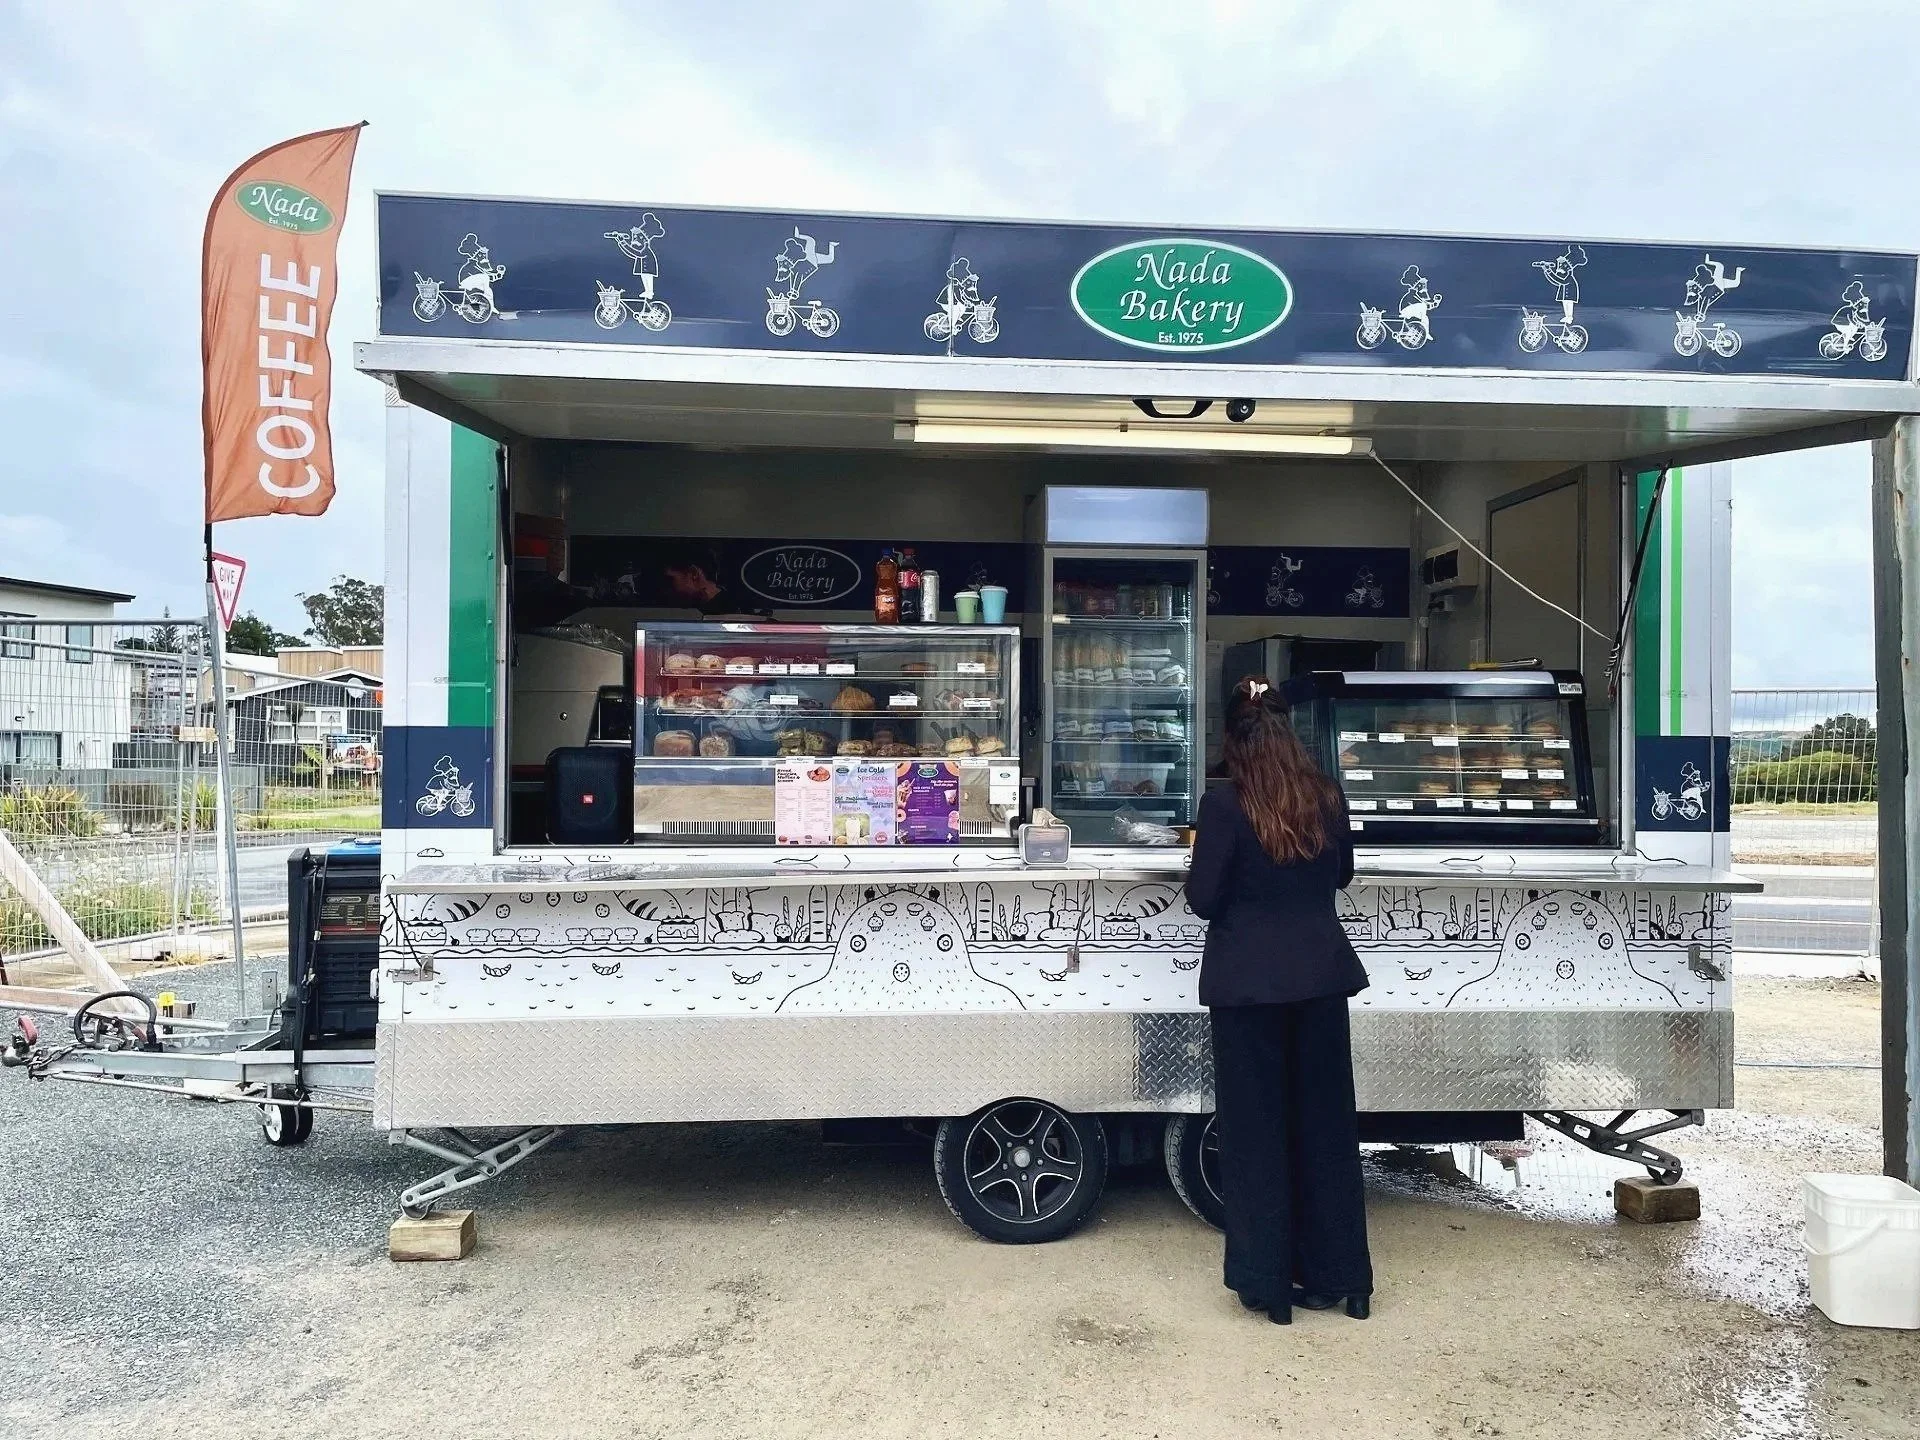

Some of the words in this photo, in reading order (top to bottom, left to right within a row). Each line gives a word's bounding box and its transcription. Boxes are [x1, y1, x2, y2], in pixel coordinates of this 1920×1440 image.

[249, 186, 319, 223] Nada
[1134, 249, 1232, 290] Nada
[1120, 287, 1244, 333] Bakery
[1158, 331, 1175, 344] Est.
[1178, 331, 1204, 344] 1975
[256, 253, 321, 498] COFFEE
[775, 550, 829, 572] Nada
[219, 566, 236, 585] GIVE
[767, 570, 835, 594] Bakery
[868, 766, 885, 774] Cold
